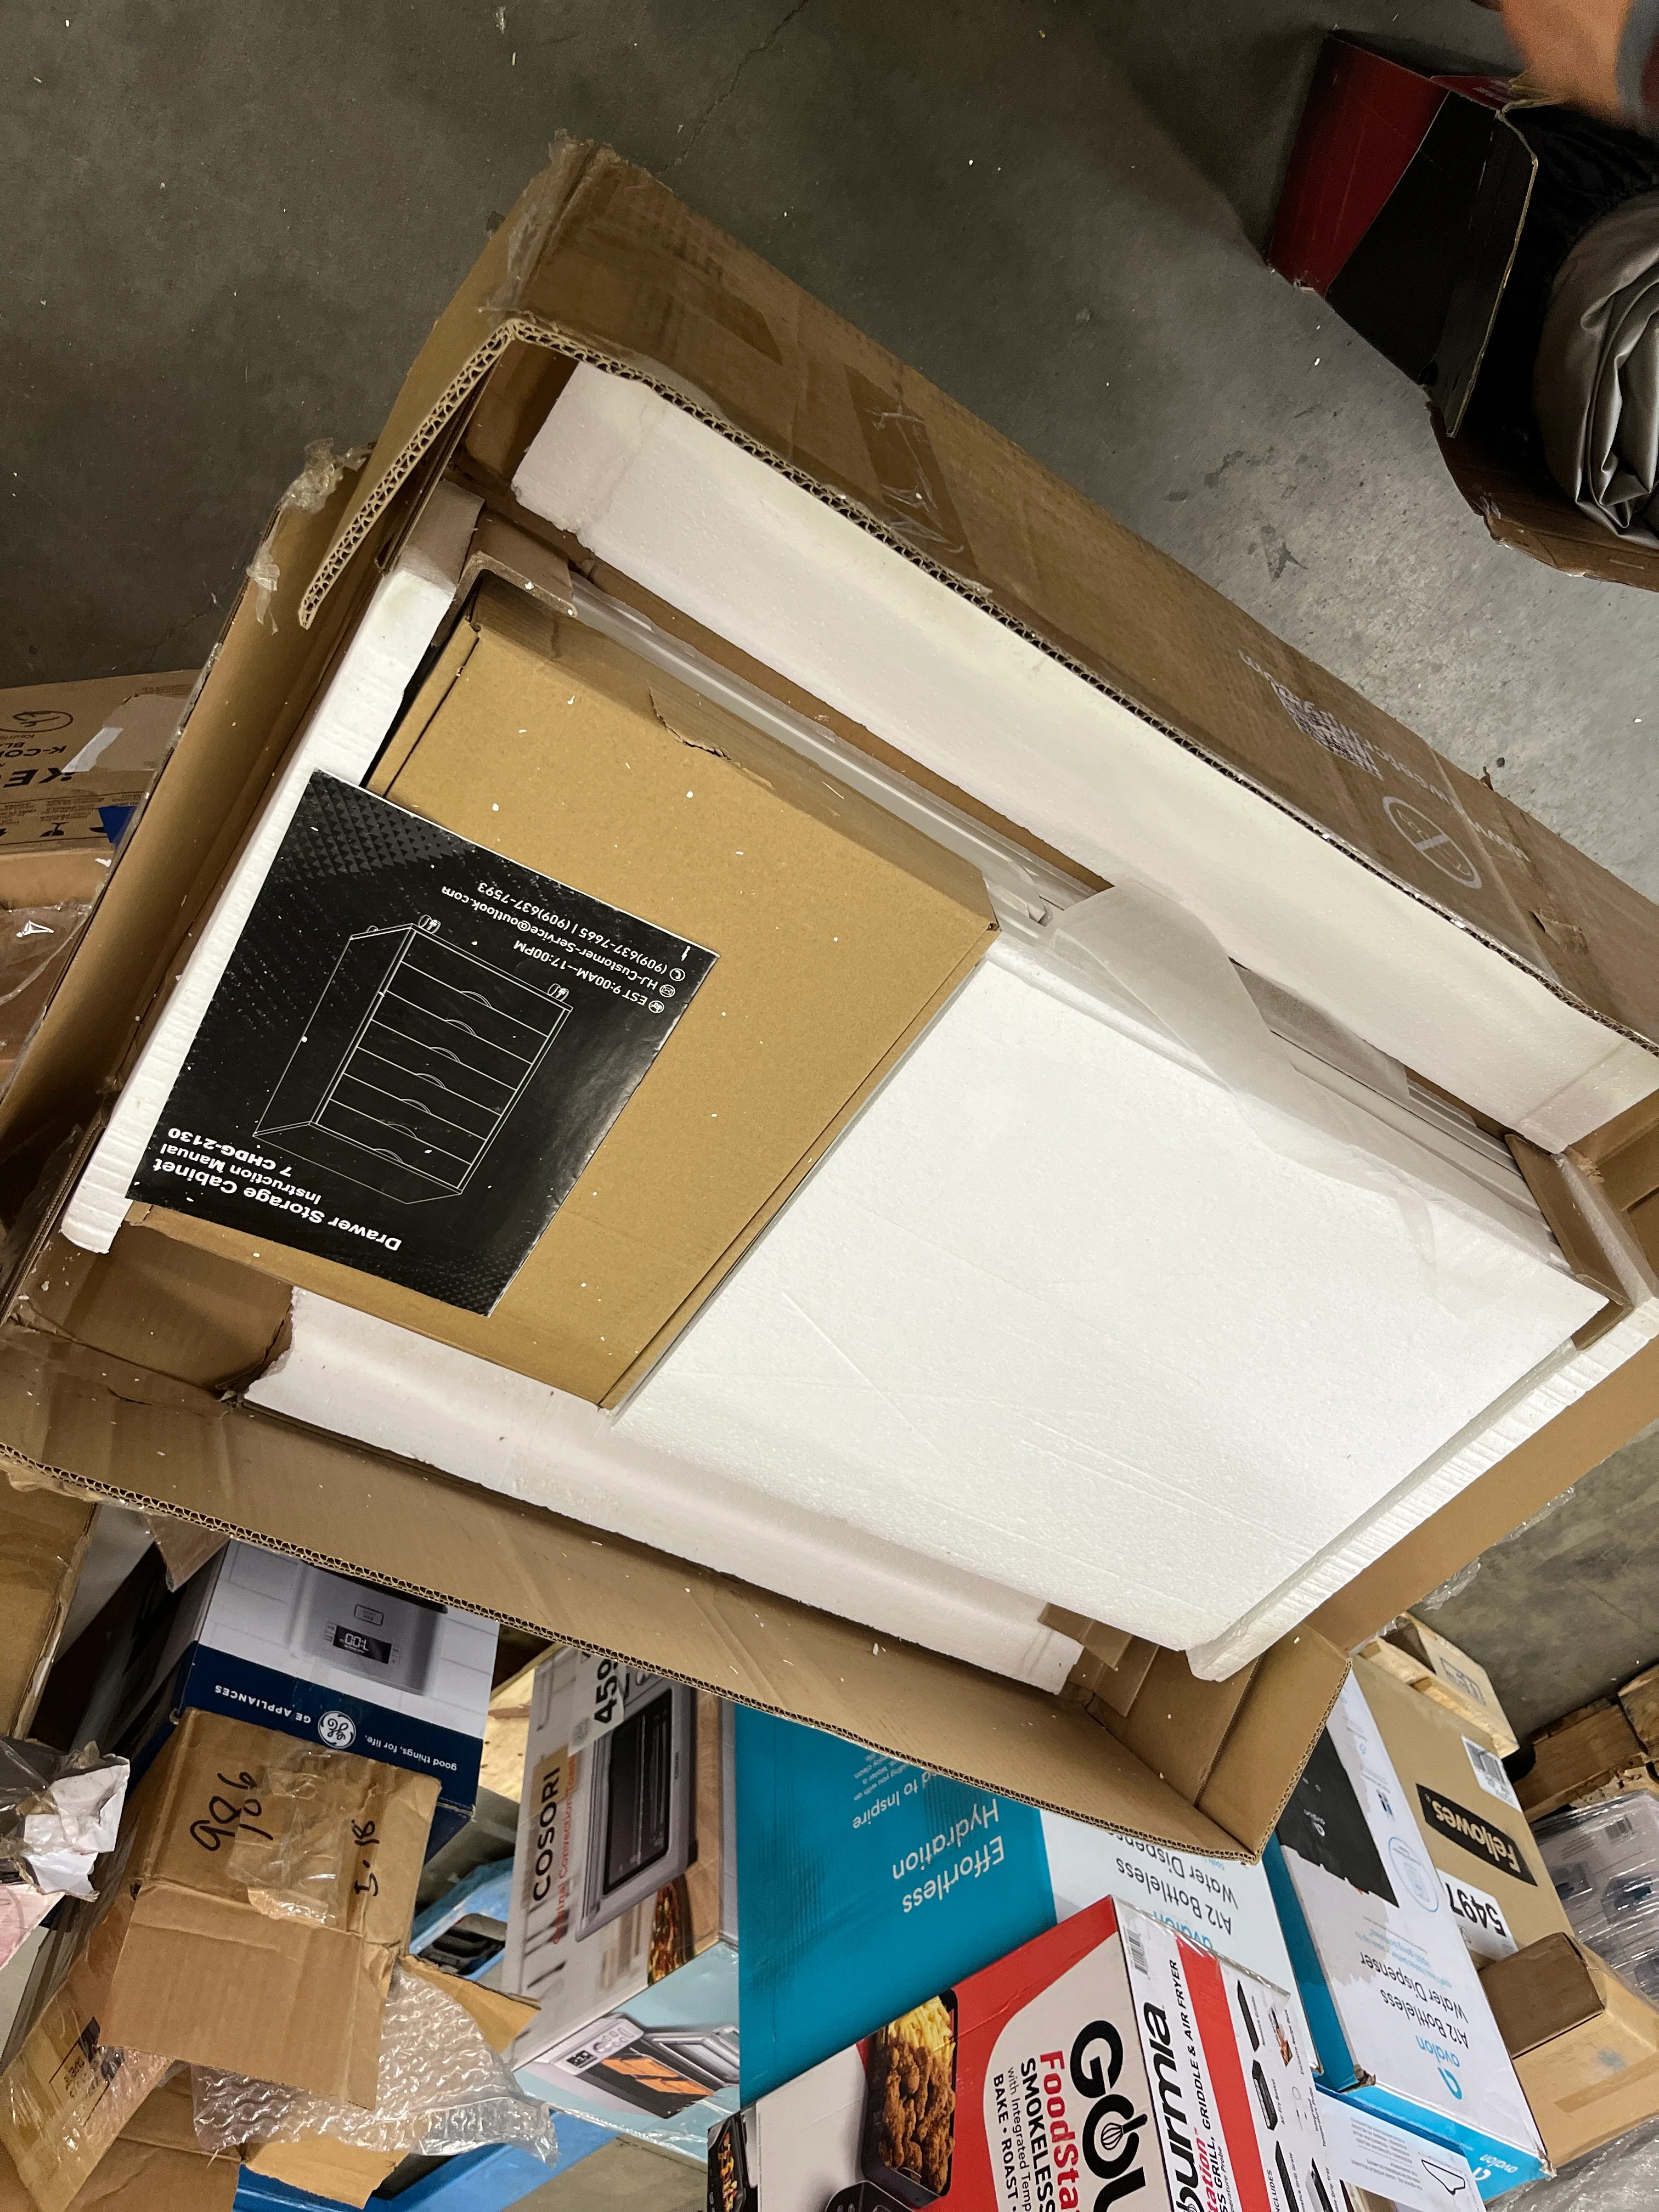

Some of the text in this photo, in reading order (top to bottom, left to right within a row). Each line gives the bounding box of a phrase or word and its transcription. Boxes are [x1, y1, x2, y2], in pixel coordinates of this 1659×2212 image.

[0, 745, 67, 758] K-CO
[0, 768, 75, 788] KE
[477, 882, 571, 933] (909)637-7593
[441, 885, 659, 990] HJ-Customer-Service@outlook.com
[578, 927, 668, 975] (909)637-7665
[622, 991, 648, 1006] EST
[160, 1143, 321, 1205] Instruction Manual
[168, 1127, 292, 1177] 7 CHDG-2130
[153, 1158, 402, 1251] Drawer Storage Cabinet
[215, 1684, 311, 1724] GE APPLIANCES
[364, 1733, 458, 1771] good things, for life.
[853, 1791, 900, 1829] Inspire
[904, 1779, 918, 1795] to
[533, 1766, 560, 1901] COSORI
[892, 1798, 999, 1880] Hydration
[1431, 1799, 1522, 1874] Fellowes
[902, 1835, 1005, 1913] Effortless
[1116, 1858, 1232, 1936] A12 Bottleless
[1189, 1865, 1239, 1910] Water
[1445, 1882, 1507, 1937] 5497
[1169, 1959, 1187, 2008] FRYER
[1360, 1952, 1428, 2002] Dispenser
[1182, 2011, 1193, 2040] AIR
[1380, 1989, 1469, 2049] A12 Bottleless
[1429, 1988, 1469, 2023] Water
[1187, 2045, 1197, 2056] &
[1415, 2035, 1460, 2068] avalon
[1007, 2067, 1018, 2095] with
[1192, 2059, 1210, 2130] GRIDDLE
[1271, 2078, 1279, 2100] Basket
[994, 2074, 1018, 2200] BAKE ROAST
[1011, 2097, 1030, 2170] Integrated
[1021, 2057, 1056, 2212] SMOKELESS
[1040, 2050, 1079, 2212] FoodSta
[1207, 2137, 1223, 2188] GRILL,
[1218, 2146, 1228, 2173] Probe
[1480, 2153, 1519, 2174] avalon
